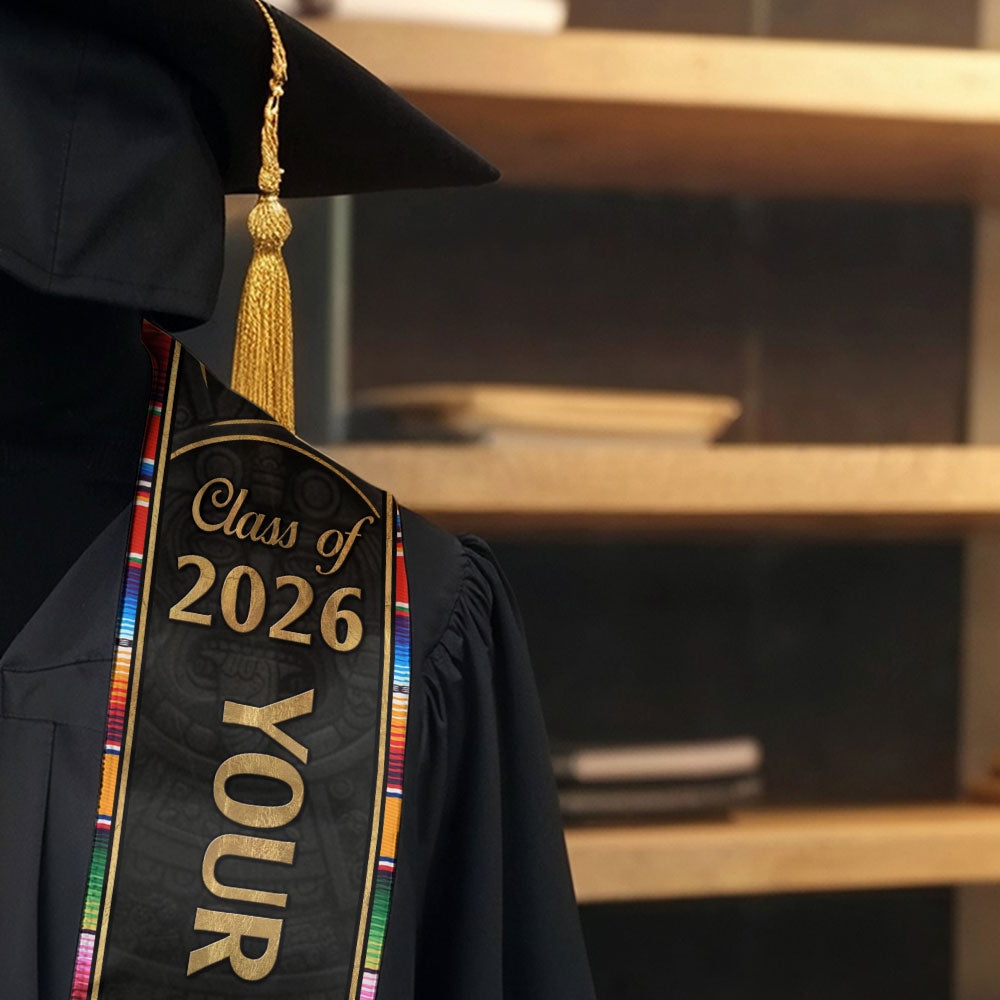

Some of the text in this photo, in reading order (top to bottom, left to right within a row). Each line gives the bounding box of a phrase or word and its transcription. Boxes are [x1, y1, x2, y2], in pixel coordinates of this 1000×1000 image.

[191, 477, 375, 575] Class of
[168, 554, 364, 652] 2026
[186, 688, 315, 982] YOUR
